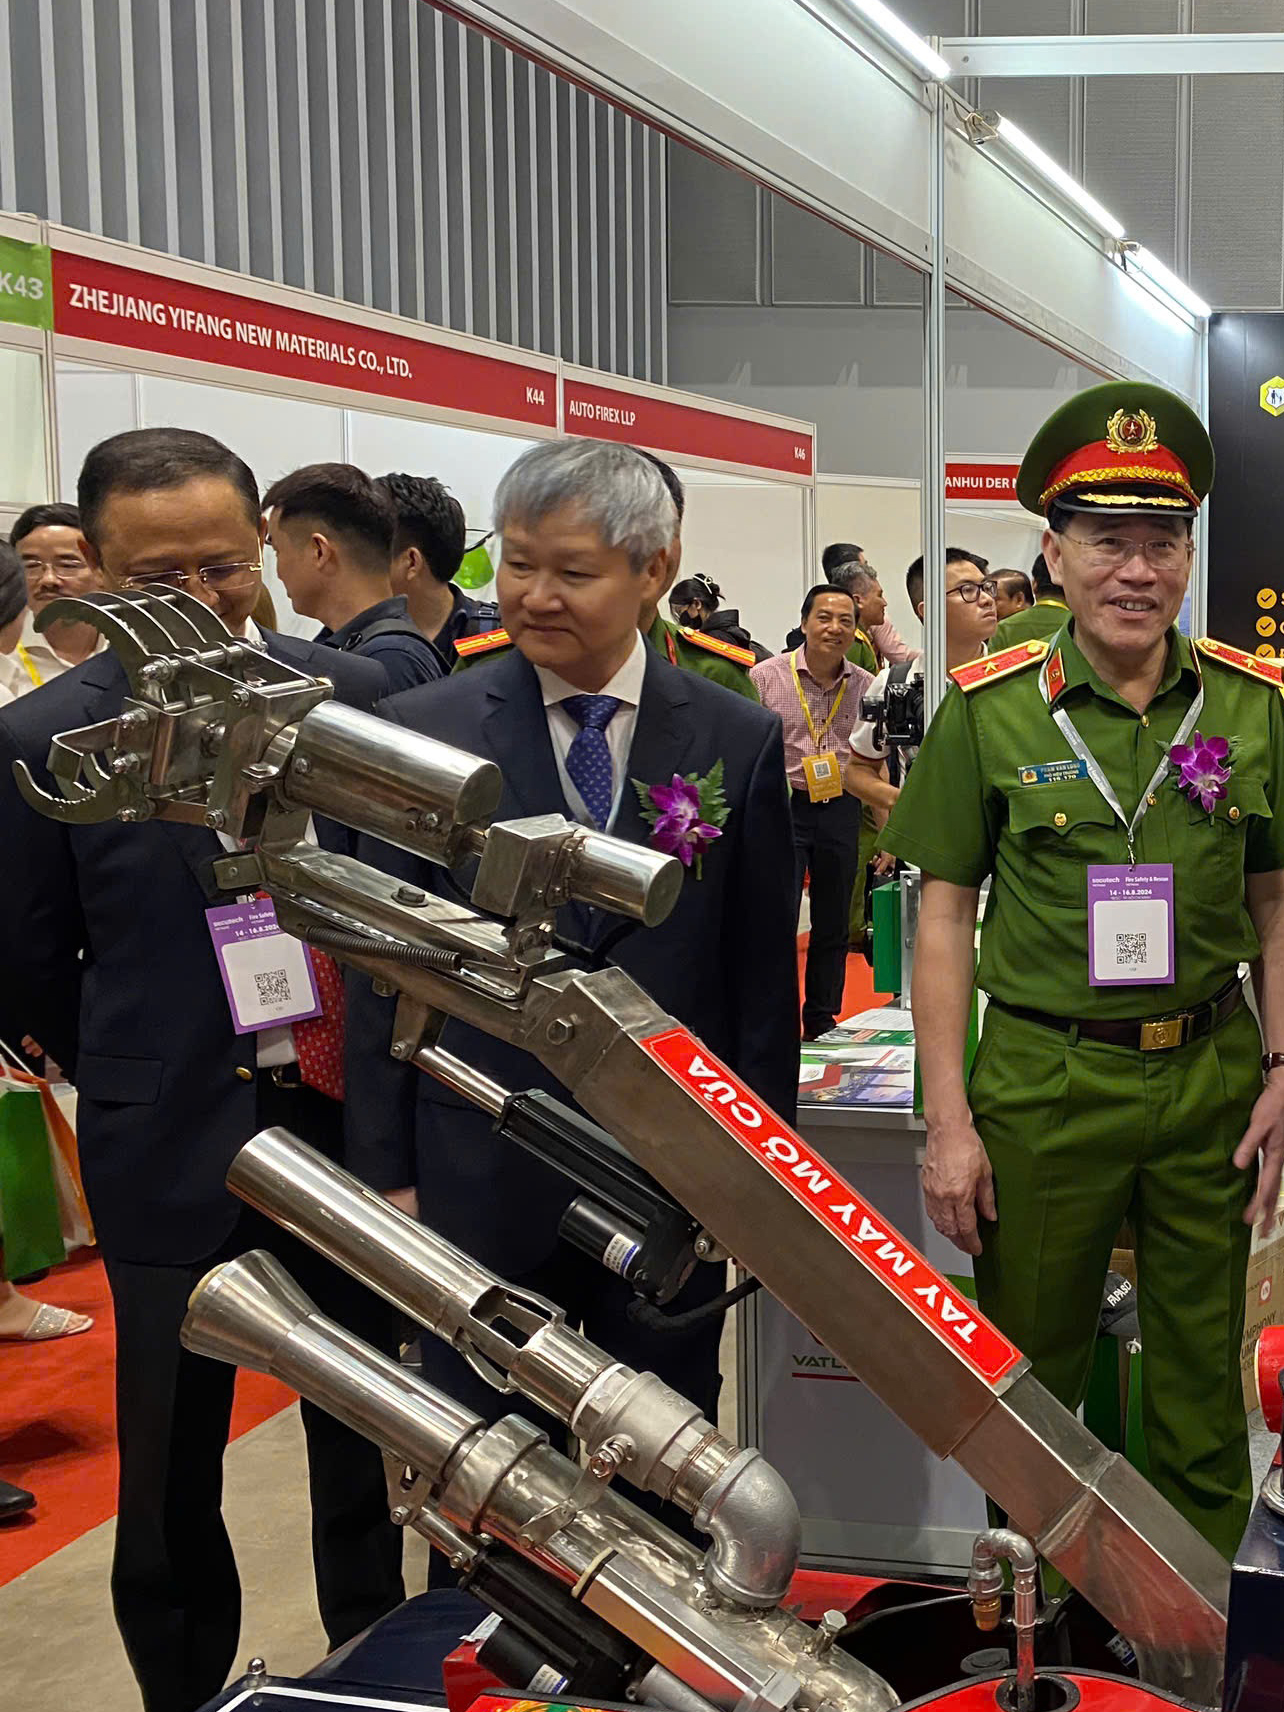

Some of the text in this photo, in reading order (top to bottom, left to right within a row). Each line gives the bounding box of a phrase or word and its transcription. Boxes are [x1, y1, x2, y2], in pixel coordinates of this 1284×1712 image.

[0, 270, 43, 300] K43
[69, 283, 412, 379] ZHEJIANG YIFANG NEW MATERIALS CO., LTD.
[526, 386, 545, 406] K44
[569, 400, 636, 426] AUTO FIREX LLP
[794, 446, 806, 461] K46
[945, 476, 983, 489] ANHUI
[986, 477, 1010, 489] DER
[688, 1055, 978, 1344] TAY MÁY MỞ CỬA
[792, 1354, 848, 1369] VATL
